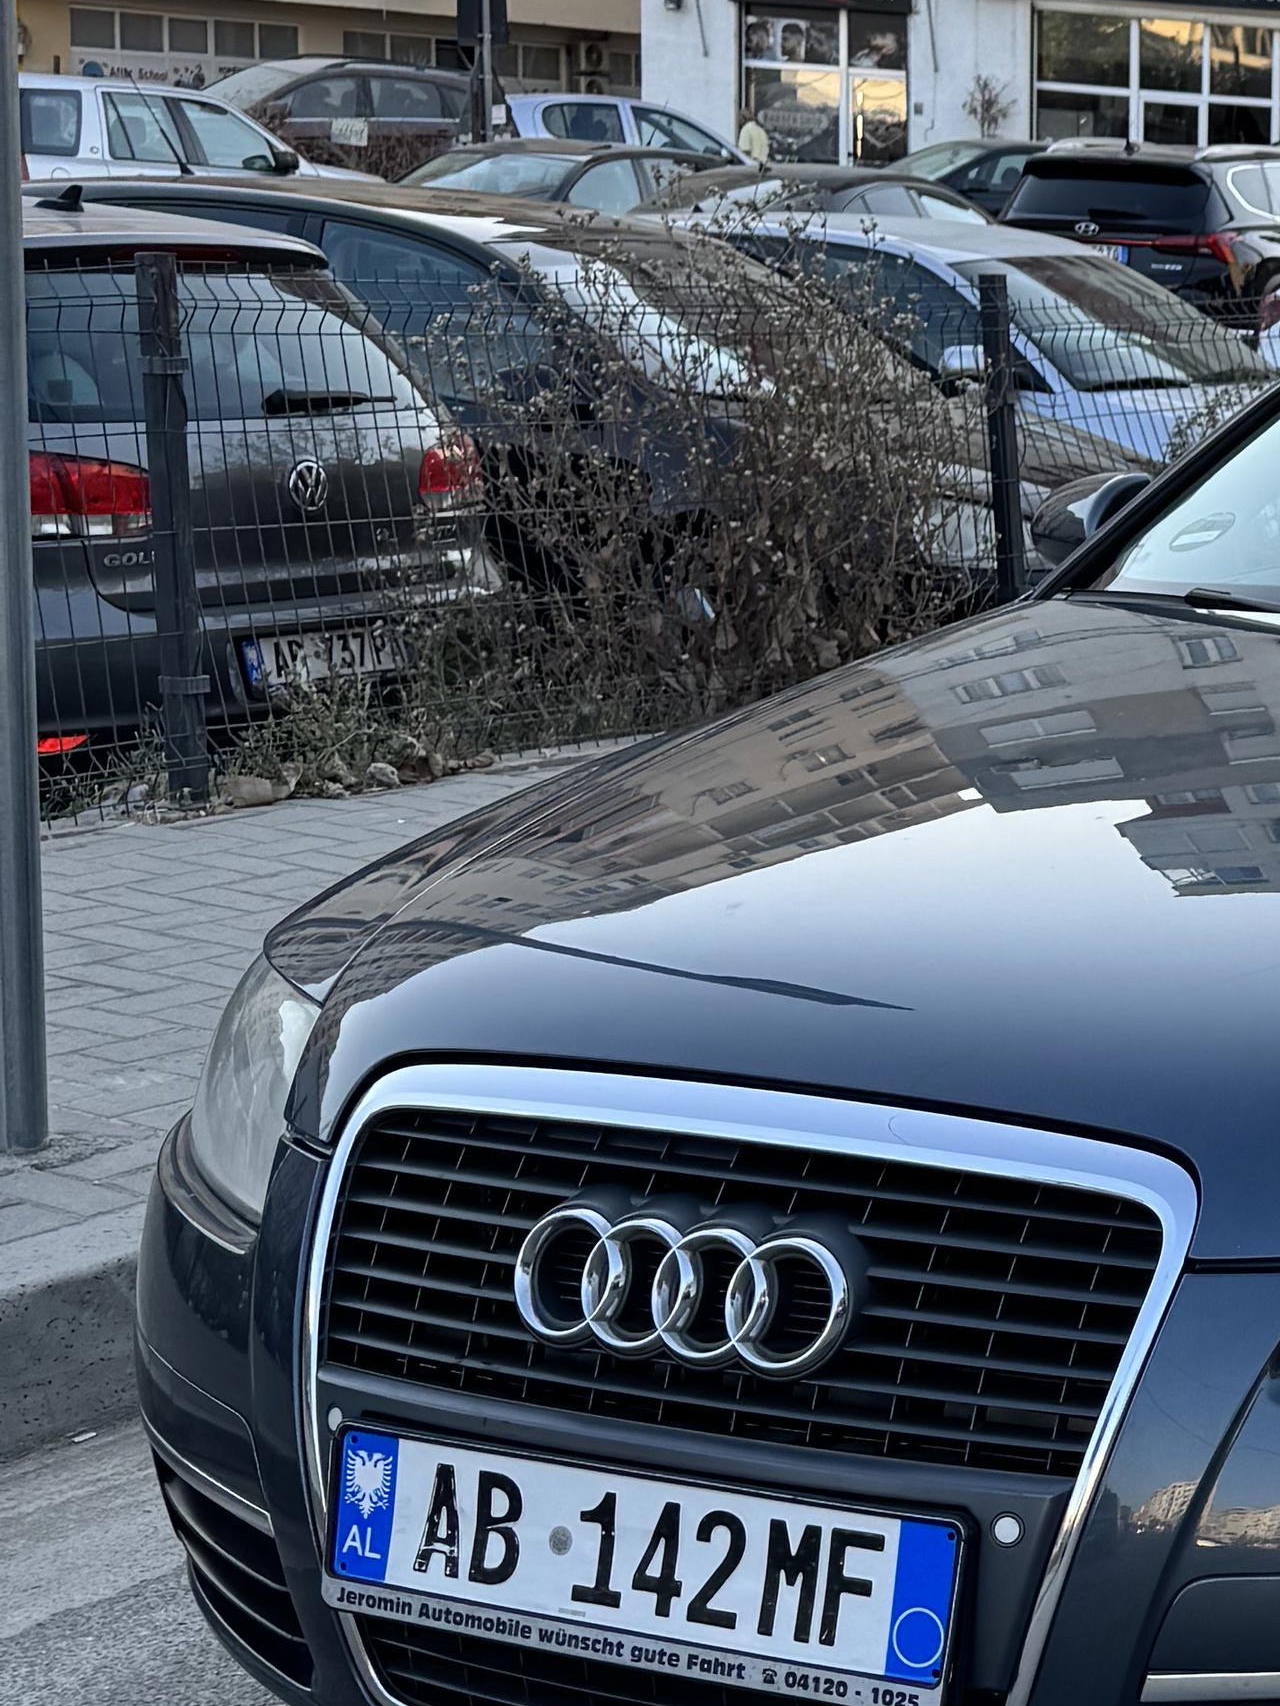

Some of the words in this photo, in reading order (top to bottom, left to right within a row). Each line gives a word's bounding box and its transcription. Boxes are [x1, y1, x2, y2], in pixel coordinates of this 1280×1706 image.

[103, 551, 155, 567] GOL
[342, 1524, 382, 1560] AL
[413, 1463, 523, 1585] AB
[337, 1587, 413, 1616] Jeromin
[418, 1603, 533, 1640] Automobile
[538, 1627, 625, 1658] wünscht
[630, 1643, 681, 1668] gute
[687, 1654, 746, 1681] Fahrt
[784, 1671, 848, 1698] 04120
